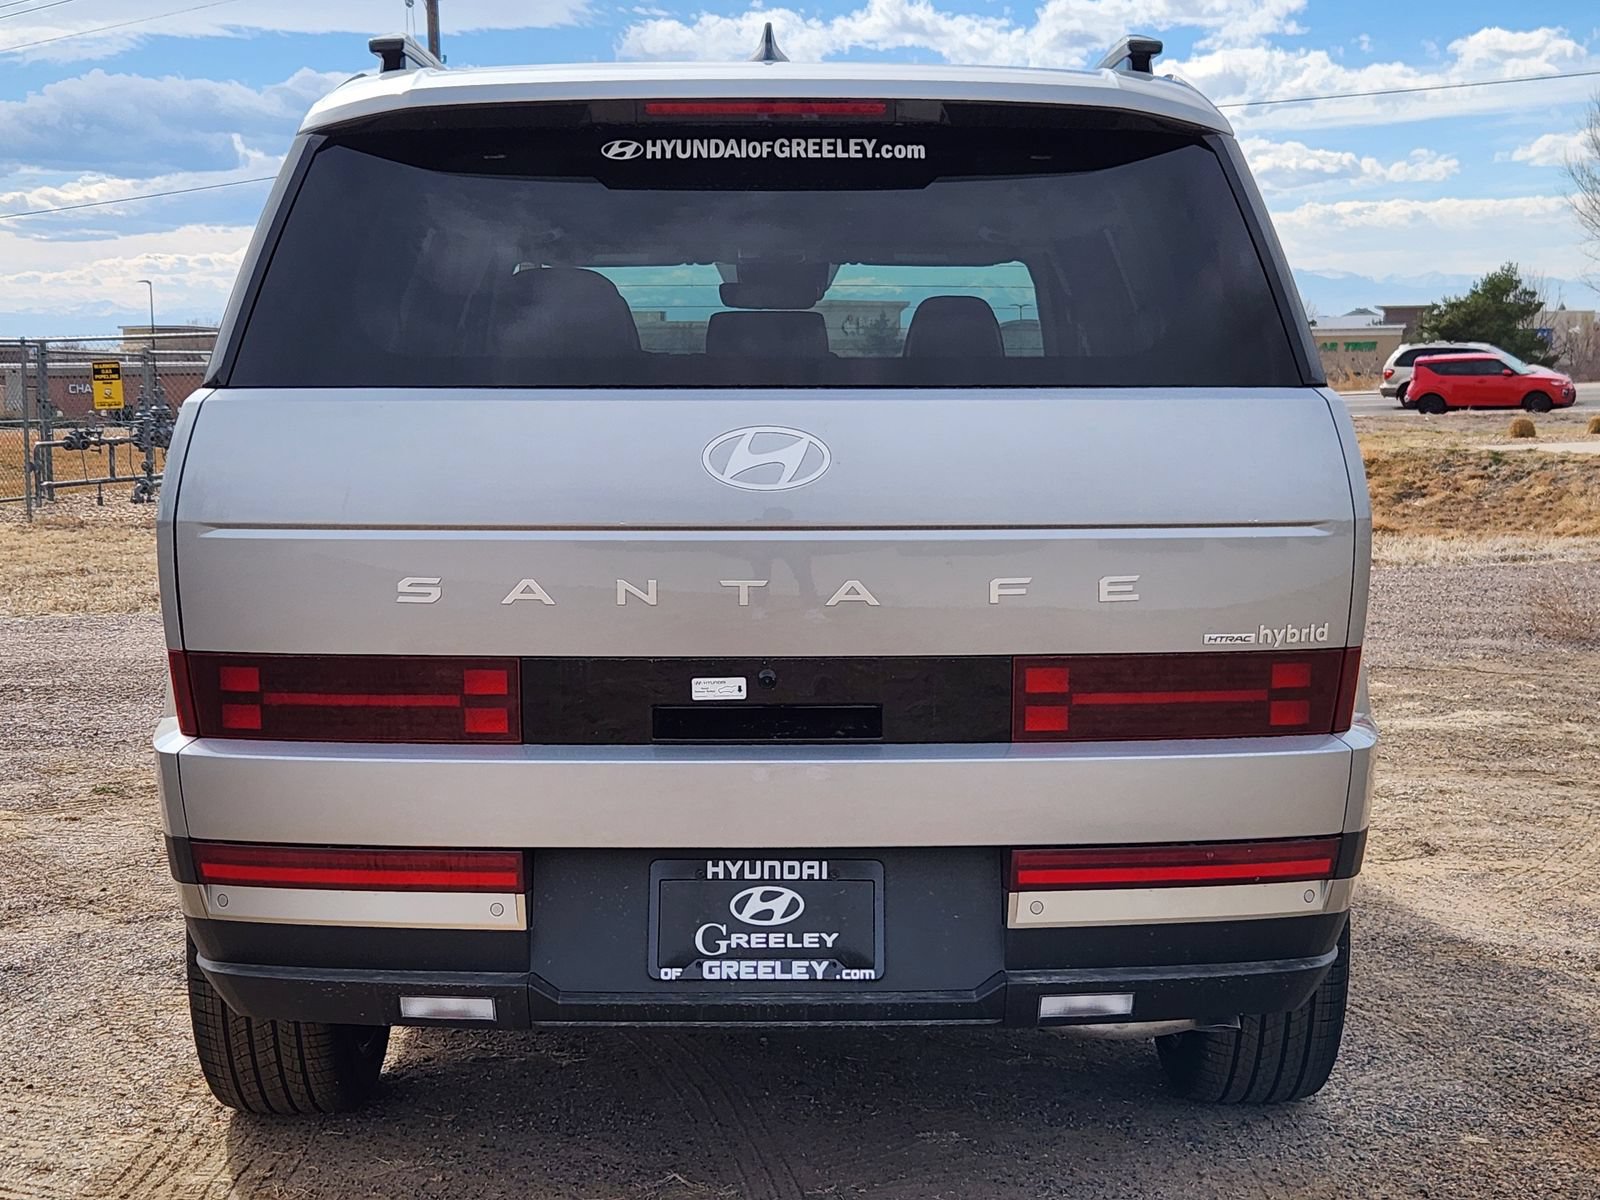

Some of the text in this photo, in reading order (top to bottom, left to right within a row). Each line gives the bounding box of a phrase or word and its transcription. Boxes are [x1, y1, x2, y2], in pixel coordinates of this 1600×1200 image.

[396, 574, 1141, 607] SANTA FE
[1207, 622, 1329, 648] HTRAC hybrid
[706, 860, 828, 880] HYUNDAI
[694, 922, 840, 956] GREELEY
[660, 960, 876, 981] OF GREELEY .com
